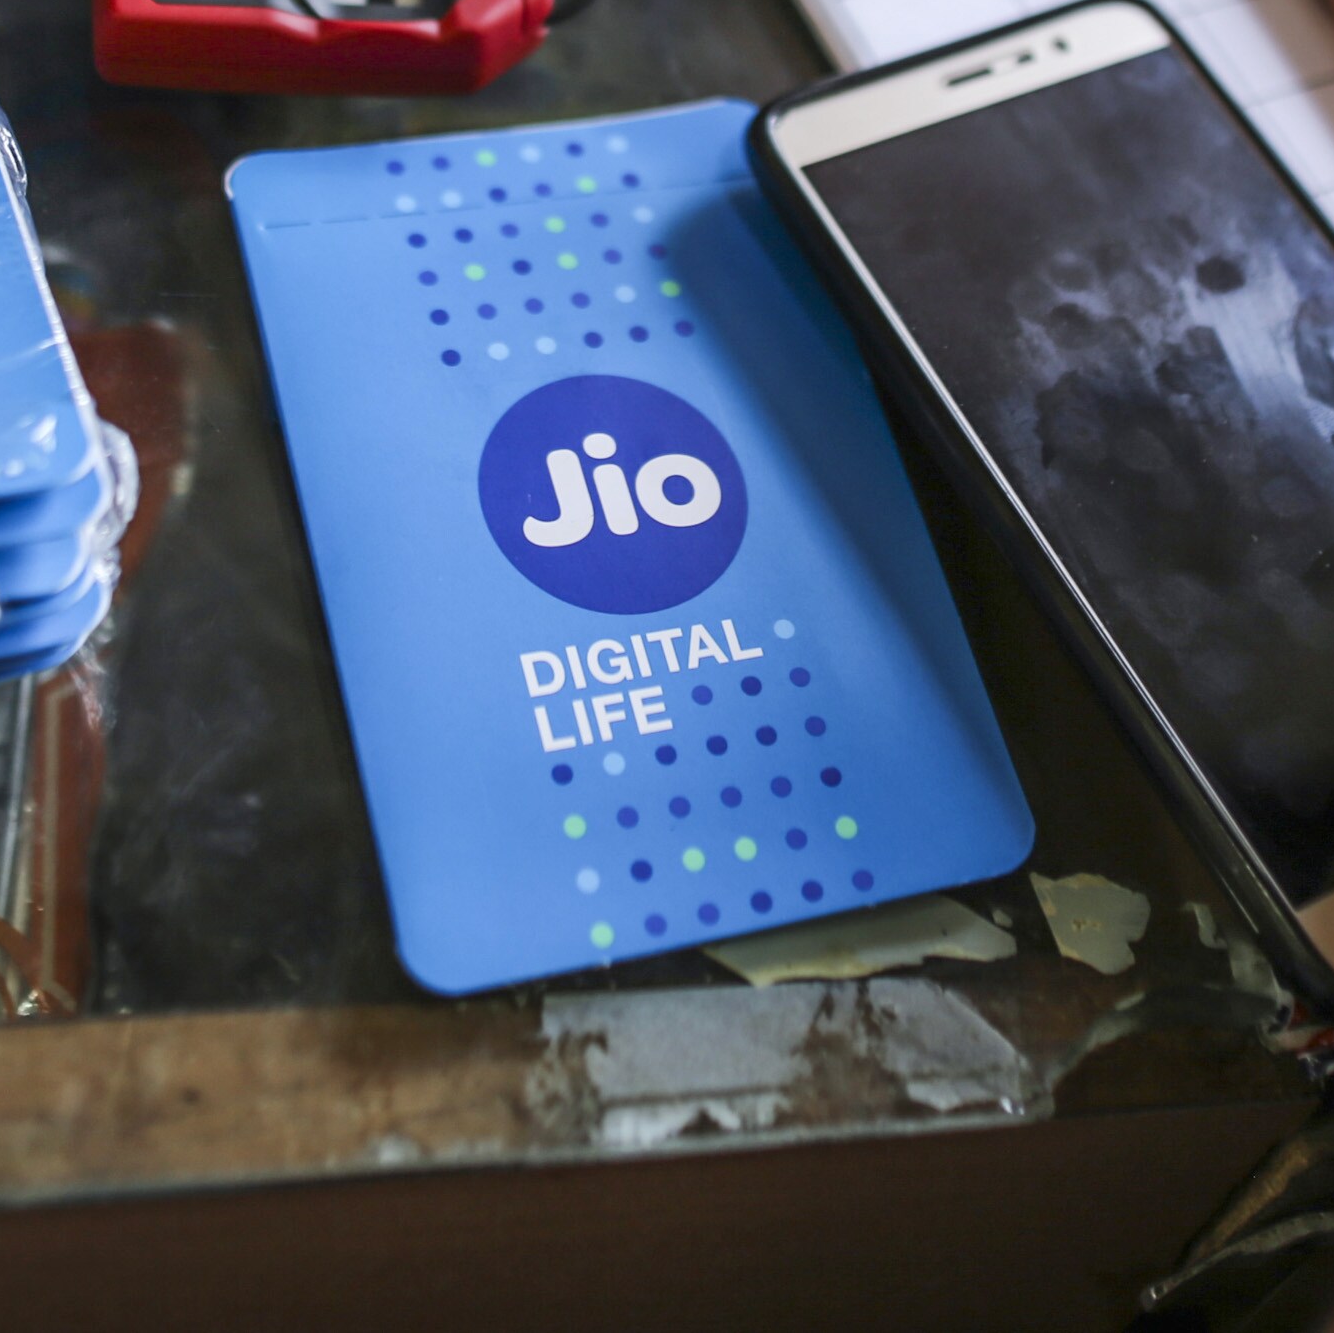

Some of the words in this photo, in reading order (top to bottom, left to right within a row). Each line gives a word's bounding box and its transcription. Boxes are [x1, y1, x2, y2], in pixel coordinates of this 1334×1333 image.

[523, 432, 722, 548] Jio
[520, 619, 764, 698] DIGITAL
[533, 685, 673, 753] LIFE
